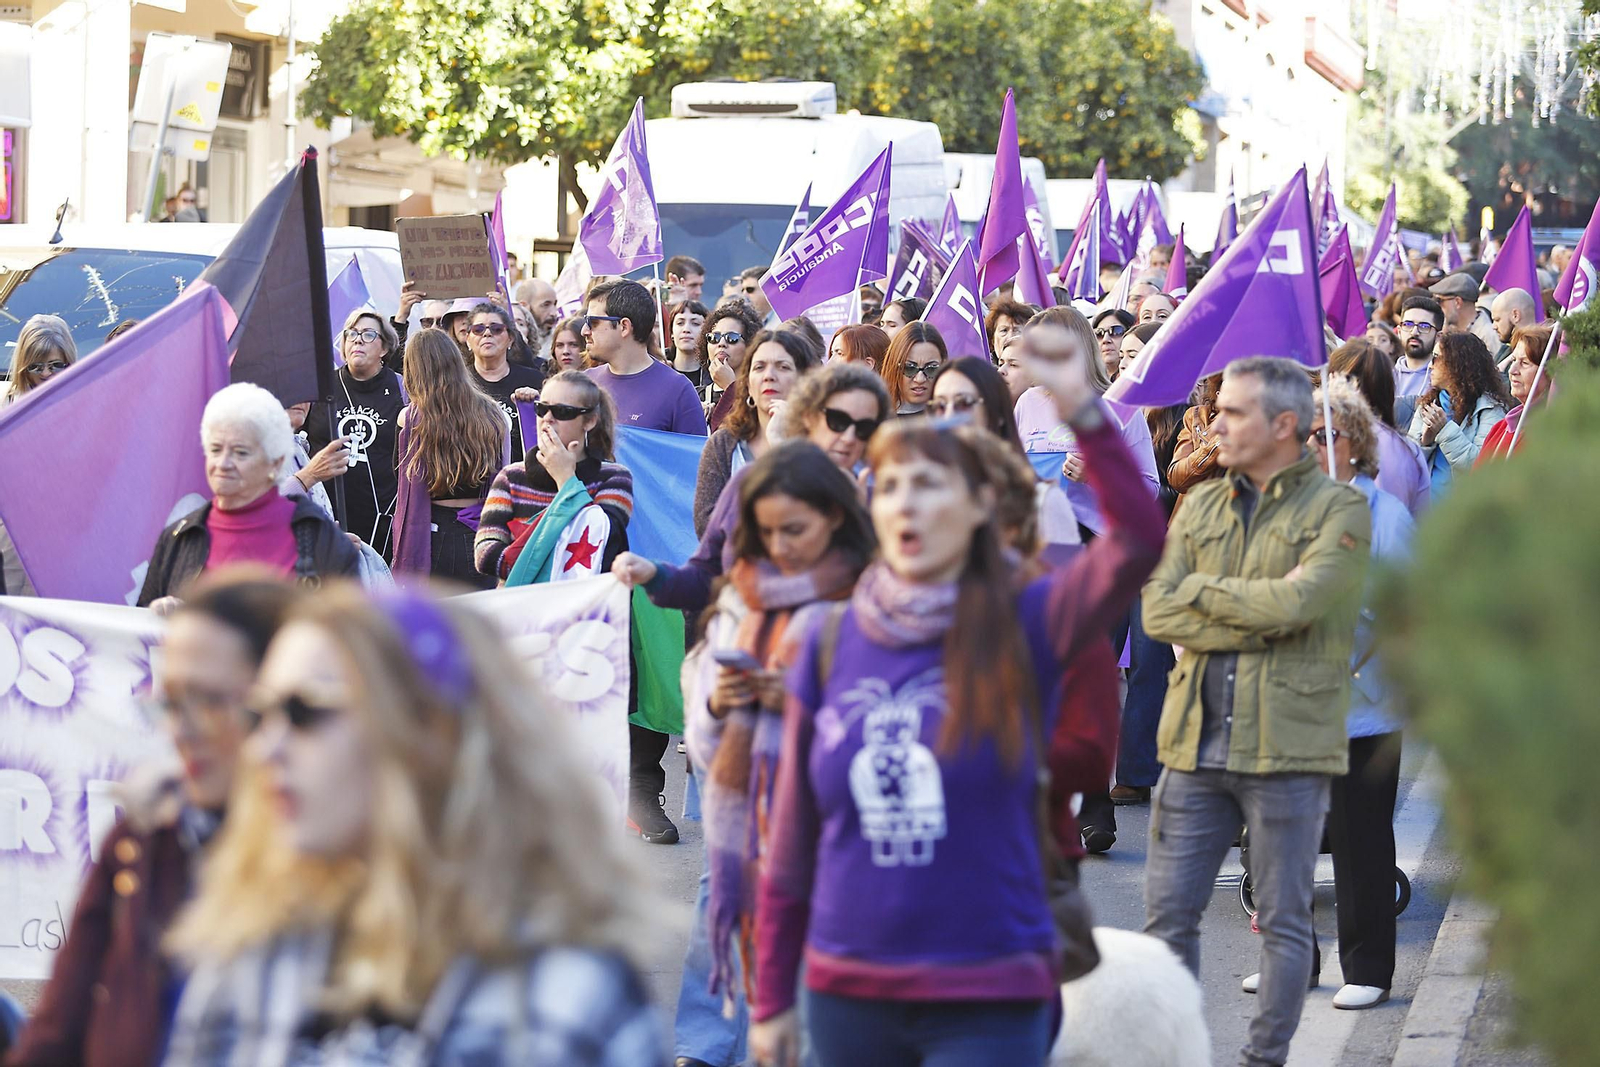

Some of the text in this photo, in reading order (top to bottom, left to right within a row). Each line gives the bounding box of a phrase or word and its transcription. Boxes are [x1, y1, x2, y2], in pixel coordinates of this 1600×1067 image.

[404, 227, 429, 242] UN
[403, 247, 415, 260] A
[407, 265, 434, 281] QUE
